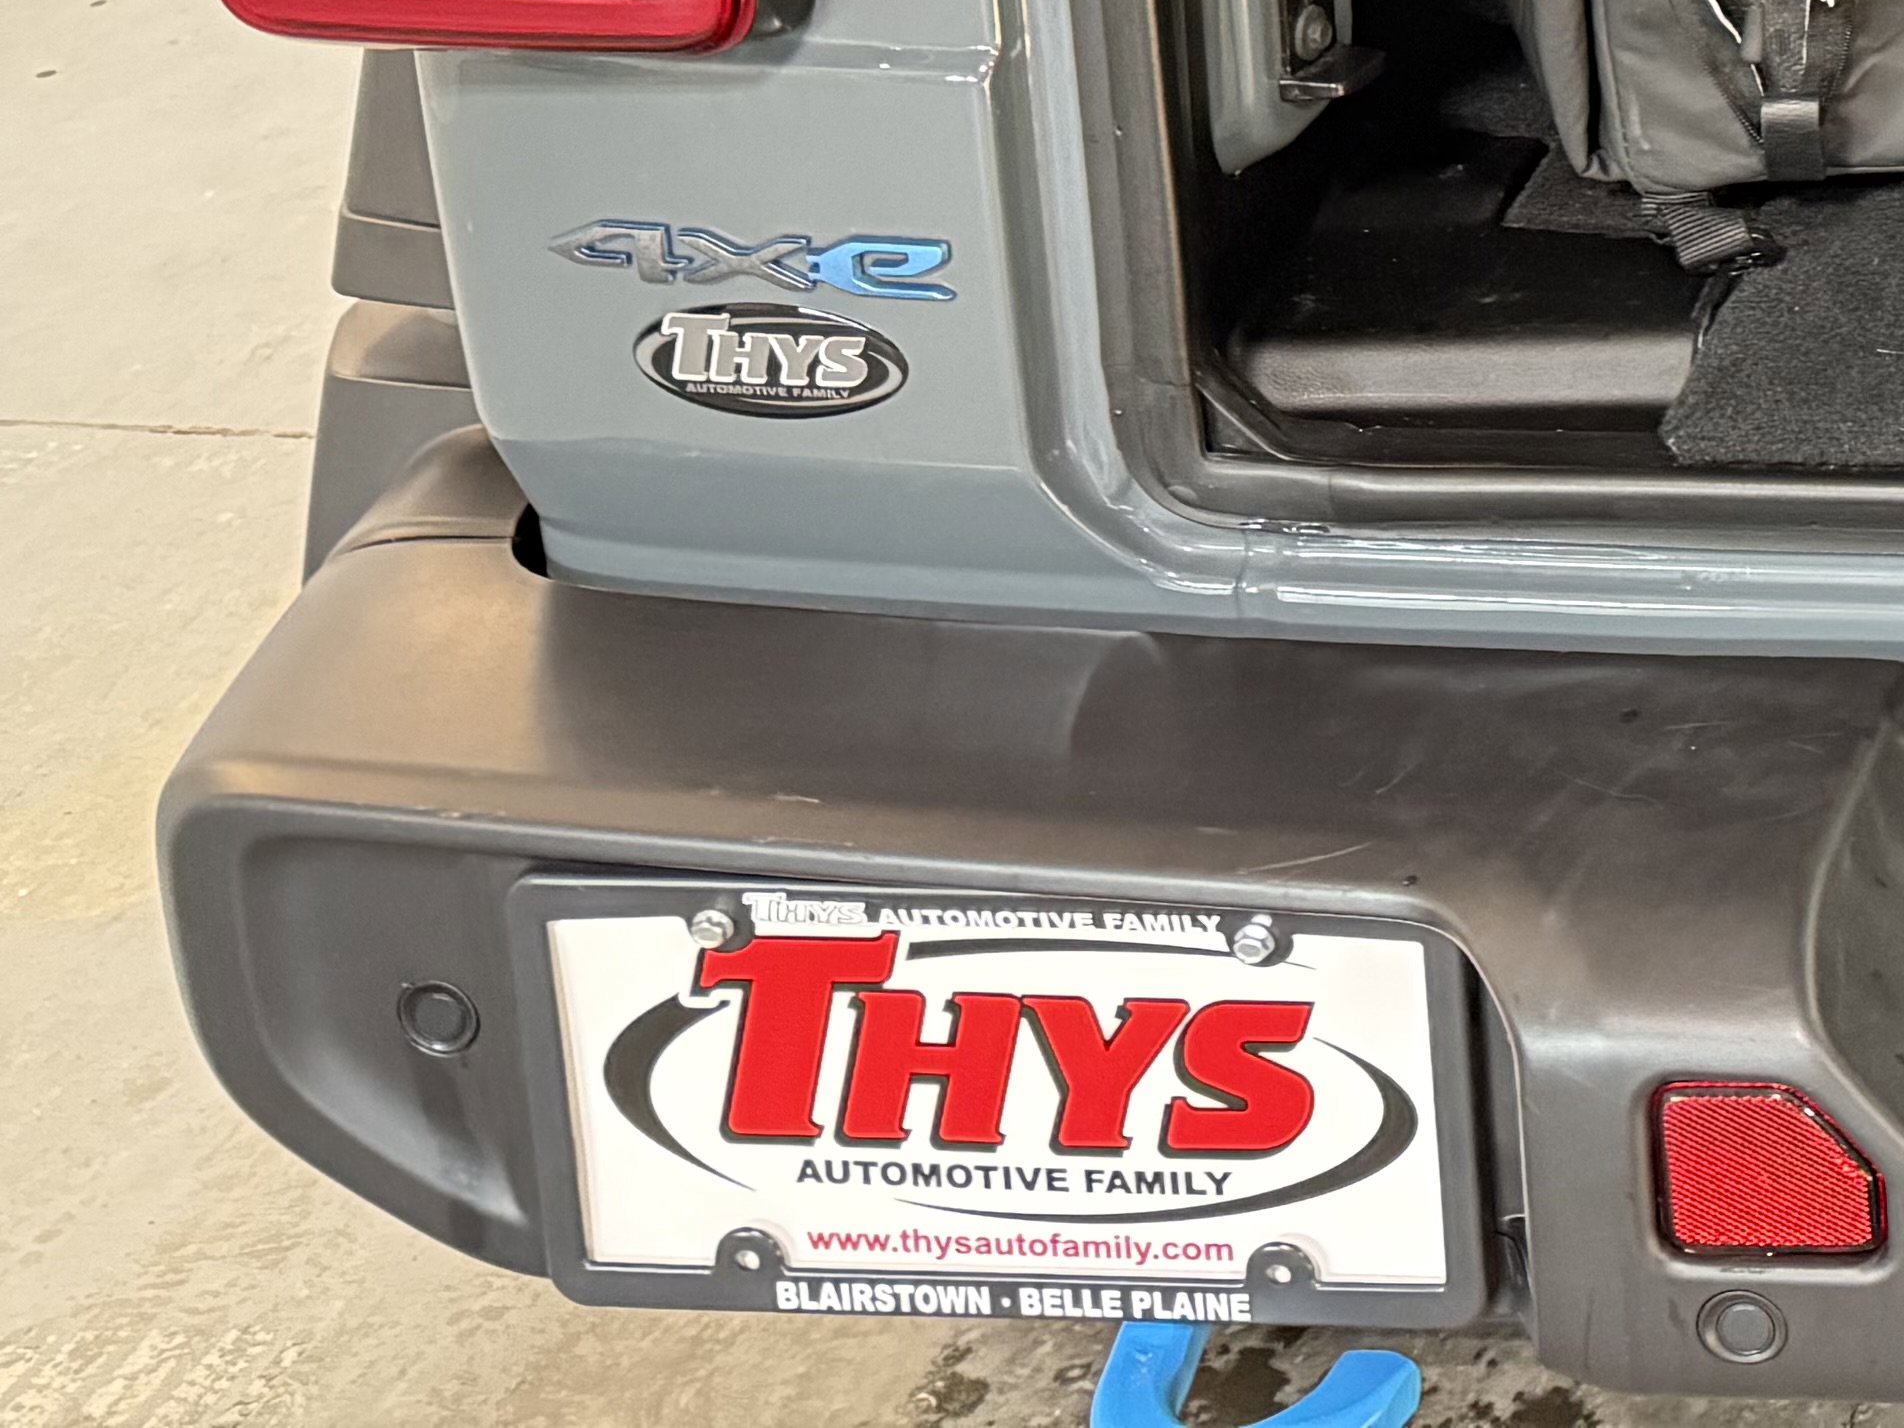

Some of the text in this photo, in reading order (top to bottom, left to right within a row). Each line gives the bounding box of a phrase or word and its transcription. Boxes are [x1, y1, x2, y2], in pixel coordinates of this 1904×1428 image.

[686, 383, 850, 399] AUTOMOTIVE FAMILY
[878, 907, 1096, 931] AUTOMOTIVE
[1101, 913, 1222, 934] FAMILY
[699, 933, 1315, 1157] THYS
[796, 1159, 1233, 1197] AUTOMOTIVE FAMILY
[807, 1228, 1235, 1265] www.thysautofamily.com
[775, 1280, 1252, 1322] BLAIRSTOWN BELLE PLAINE
